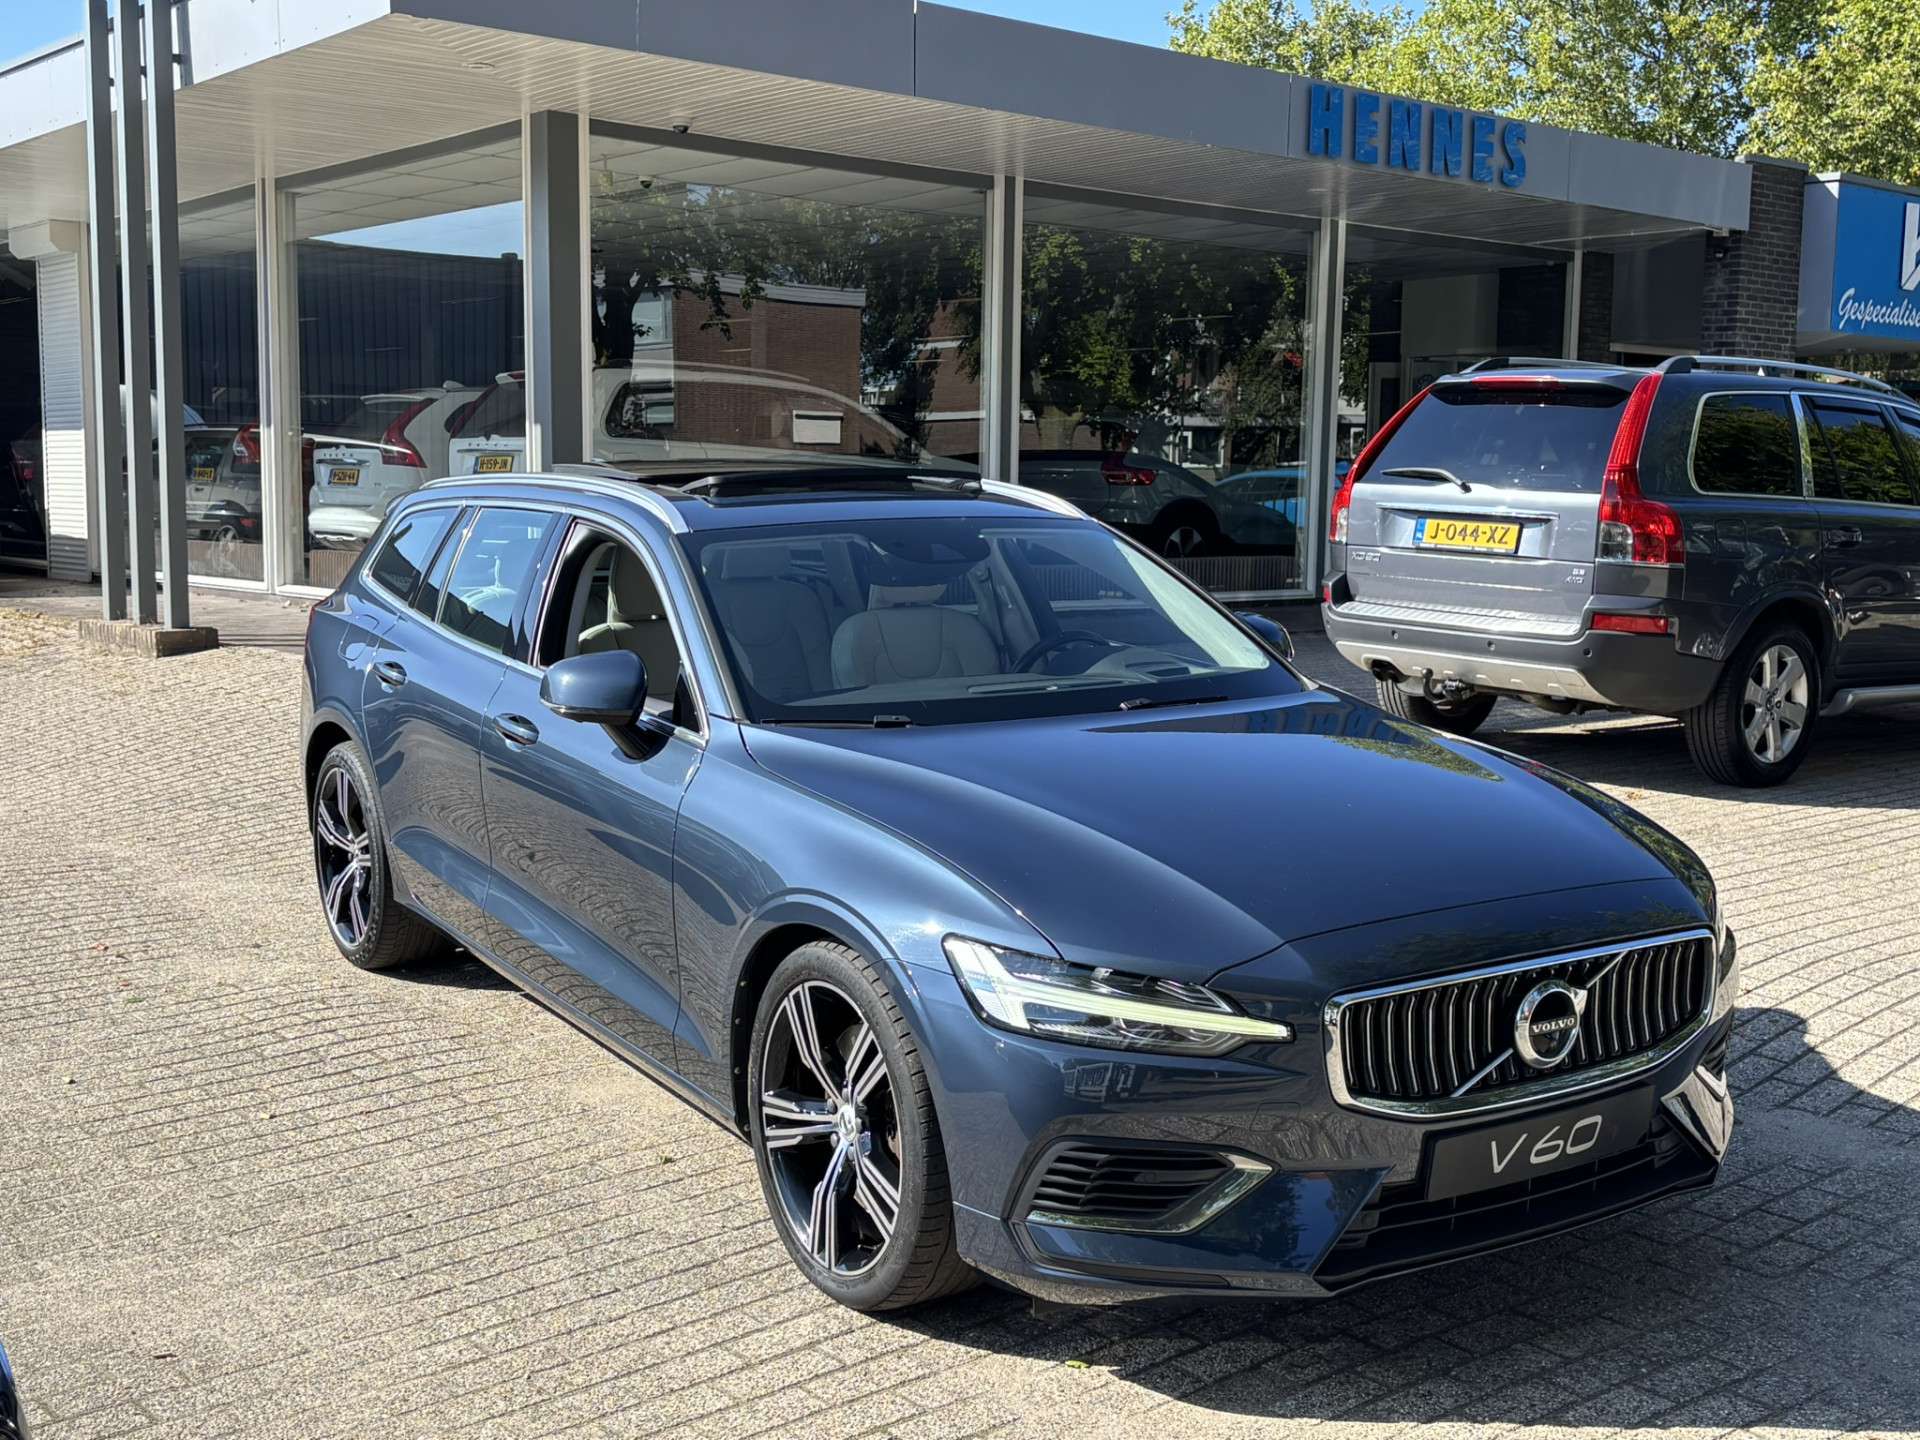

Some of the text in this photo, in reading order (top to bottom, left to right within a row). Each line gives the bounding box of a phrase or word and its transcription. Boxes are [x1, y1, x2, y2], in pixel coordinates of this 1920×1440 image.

[1309, 84, 1527, 188] HENNES
[1430, 522, 1510, 545] J-044-XZ
[1532, 1017, 1575, 1033] VOLVO
[1491, 1115, 1602, 1174] V60
